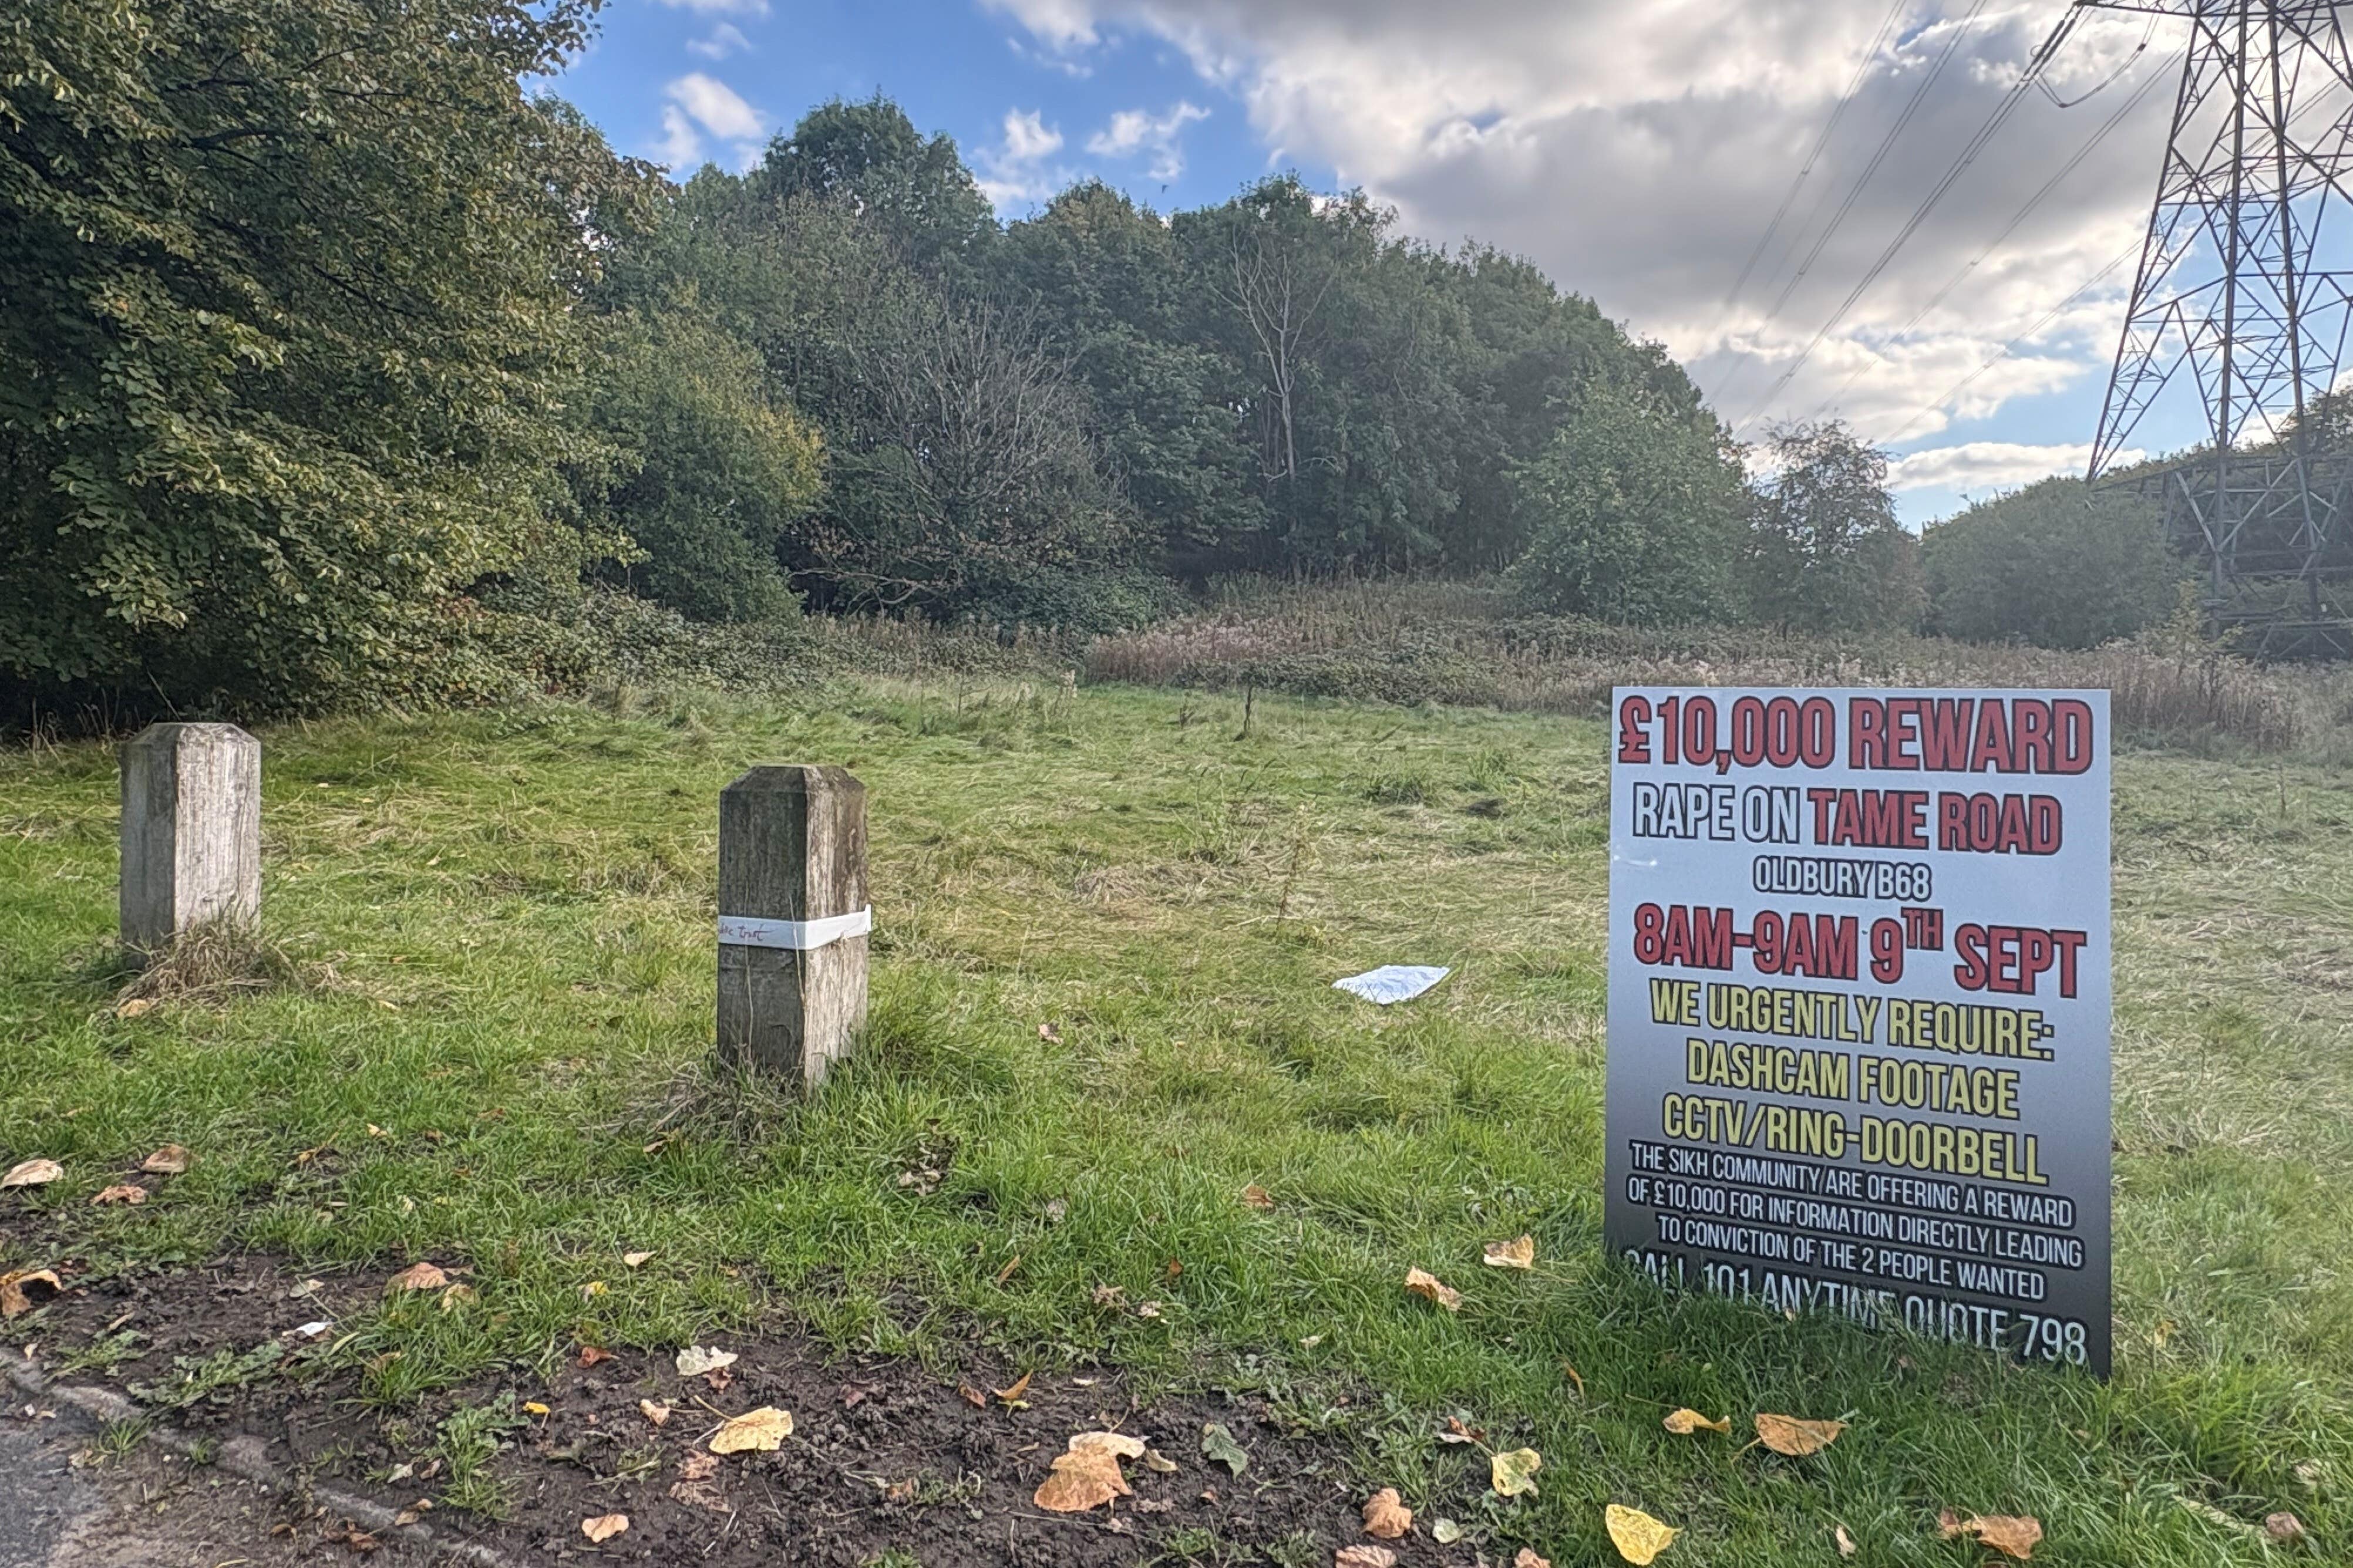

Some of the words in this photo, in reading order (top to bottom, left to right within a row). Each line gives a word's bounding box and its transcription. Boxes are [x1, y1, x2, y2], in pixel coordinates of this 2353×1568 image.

[1618, 695, 1836, 775] £10,000
[1849, 697, 2093, 775] REWARD
[1633, 782, 1735, 841] RAPE
[1743, 785, 1799, 844] ON
[1807, 788, 1929, 850] TAME
[1938, 792, 2062, 855] ROAD
[1753, 856, 1873, 898] OLDBURY
[1875, 862, 1932, 901] B68
[1634, 903, 1859, 980] 8AM-9AM
[1870, 907, 1944, 983] 9TH
[1954, 923, 2087, 998] SEPT
[1650, 978, 1700, 1026] WE
[1708, 983, 1880, 1044] URGENTLY
[1887, 999, 2055, 1061] REQUIRE:
[1687, 1038, 1849, 1100] DASHCAM
[1859, 1055, 2019, 1119] FOOTAGE
[1662, 1093, 2049, 1184] CCTV/RING-DOORBELL
[1628, 1177, 1650, 1202] OF
[1654, 1182, 1725, 1214] £10,000
[1730, 1192, 1763, 1219] FOR
[1769, 1198, 1893, 1239] INFORMATION
[1898, 1216, 1990, 1253] DIRECTLY
[1995, 1229, 2083, 1267] LEADING
[1632, 1143, 1665, 1170] THE
[1669, 1148, 1708, 1176] SIKH
[1712, 1154, 1820, 1192] COMMUNITY
[1825, 1169, 1863, 1198] ARE
[1867, 1174, 1959, 1212] OFFERING
[1964, 1188, 1978, 1215] A
[1984, 1192, 2072, 1227] REWARD
[1658, 1215, 1681, 1242] TO
[1685, 1220, 1789, 1260] CONVICTION
[1794, 1236, 1816, 1263] OF
[1821, 1240, 1856, 1271] THE
[1862, 1247, 1874, 1273] 2
[1880, 1251, 1952, 1286] PEOPLE
[1957, 1260, 2044, 1300] WANTED
[1704, 1263, 1749, 1305] 101
[1905, 1296, 2009, 1351] QUOTE
[2019, 1314, 2086, 1365] 798
